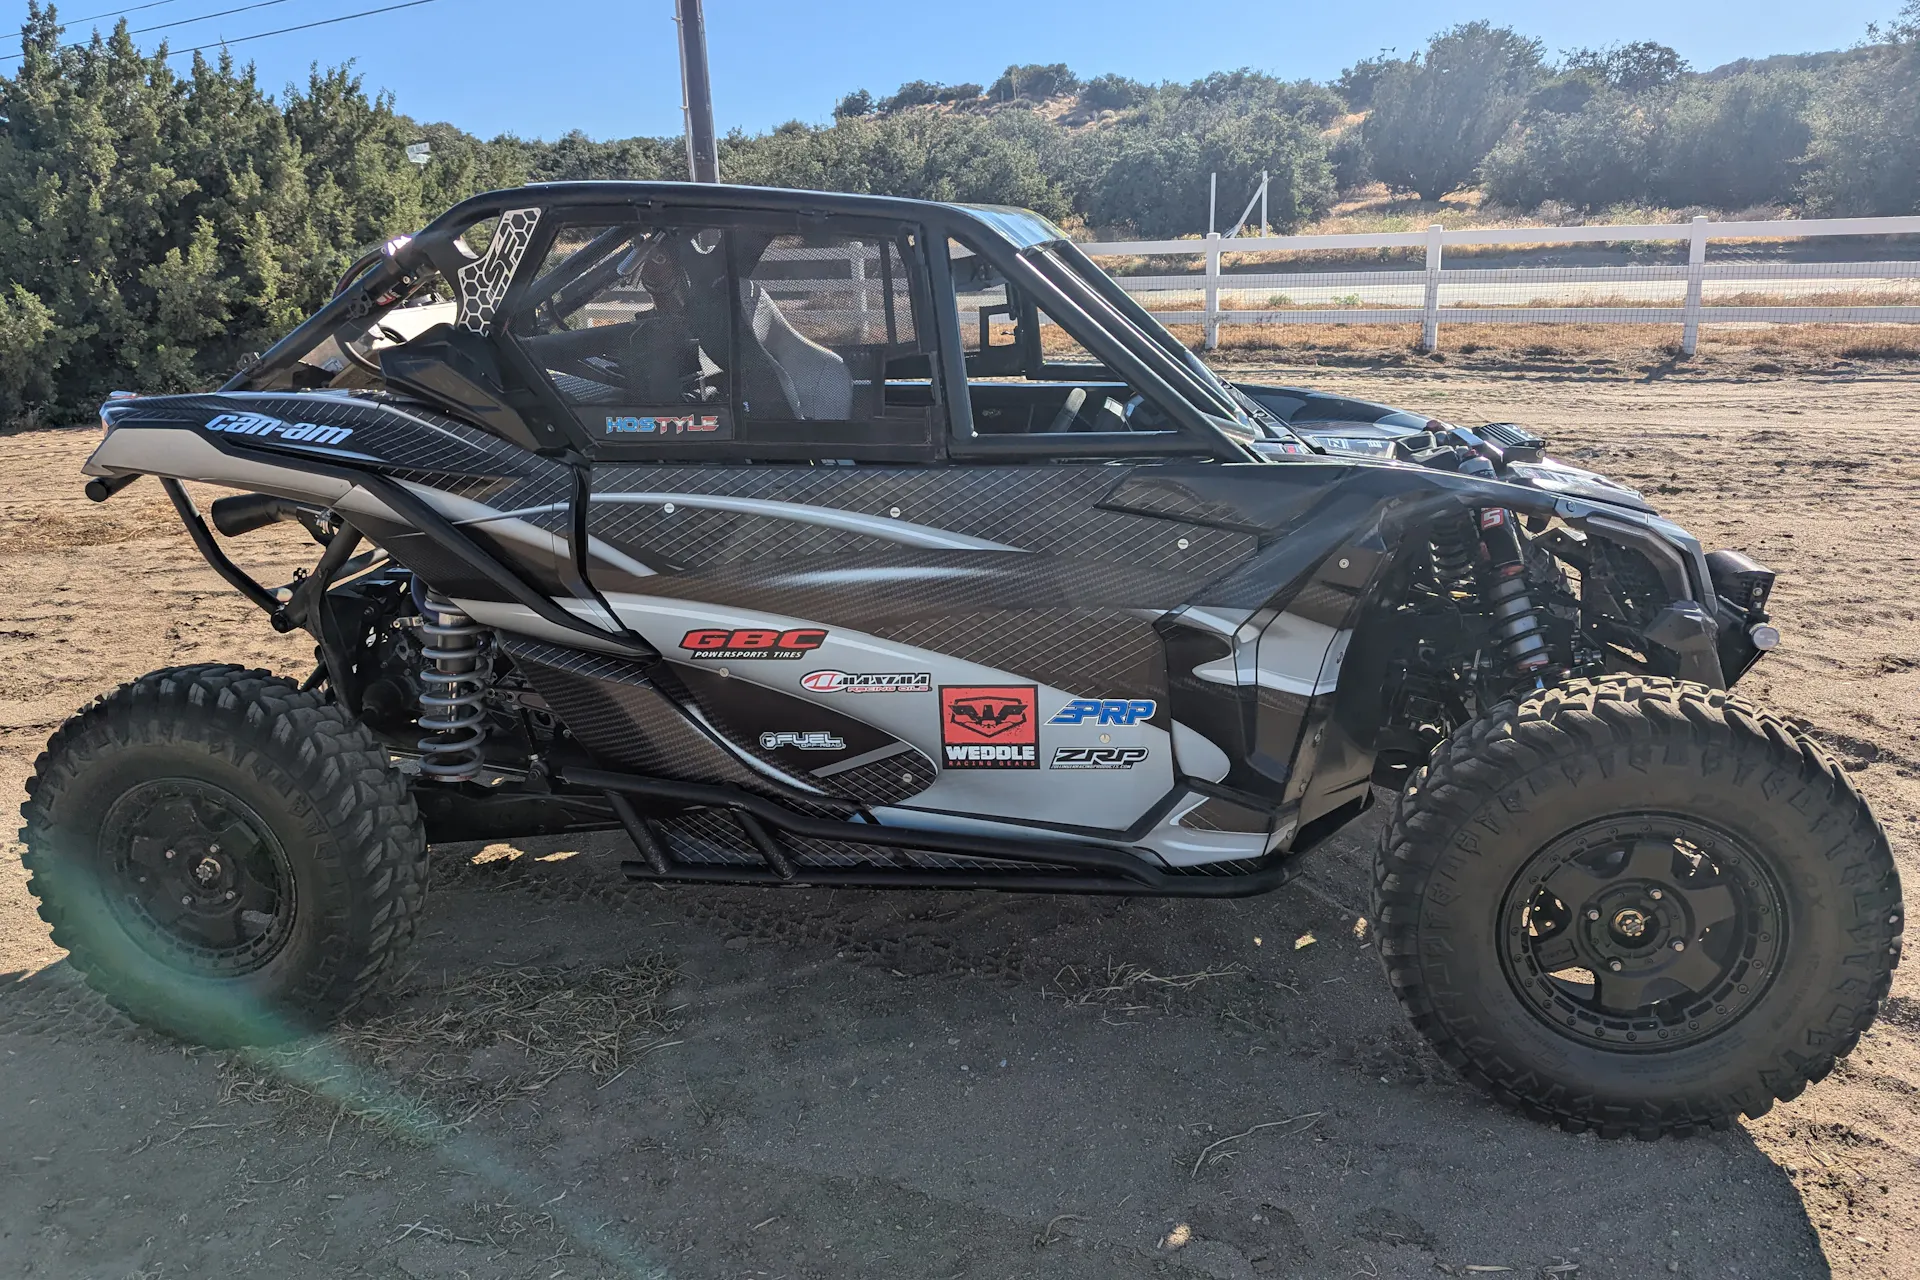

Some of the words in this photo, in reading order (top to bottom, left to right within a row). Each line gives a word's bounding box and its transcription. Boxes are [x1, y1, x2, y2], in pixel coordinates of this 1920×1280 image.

[205, 414, 354, 445] can-am
[606, 414, 719, 435] HOSTYLE
[682, 630, 825, 649] GBC
[1050, 700, 1156, 725] PRP
[777, 733, 841, 744] FUEL
[945, 745, 1035, 760] WEDDLE
[1054, 748, 1148, 764] ZRP
